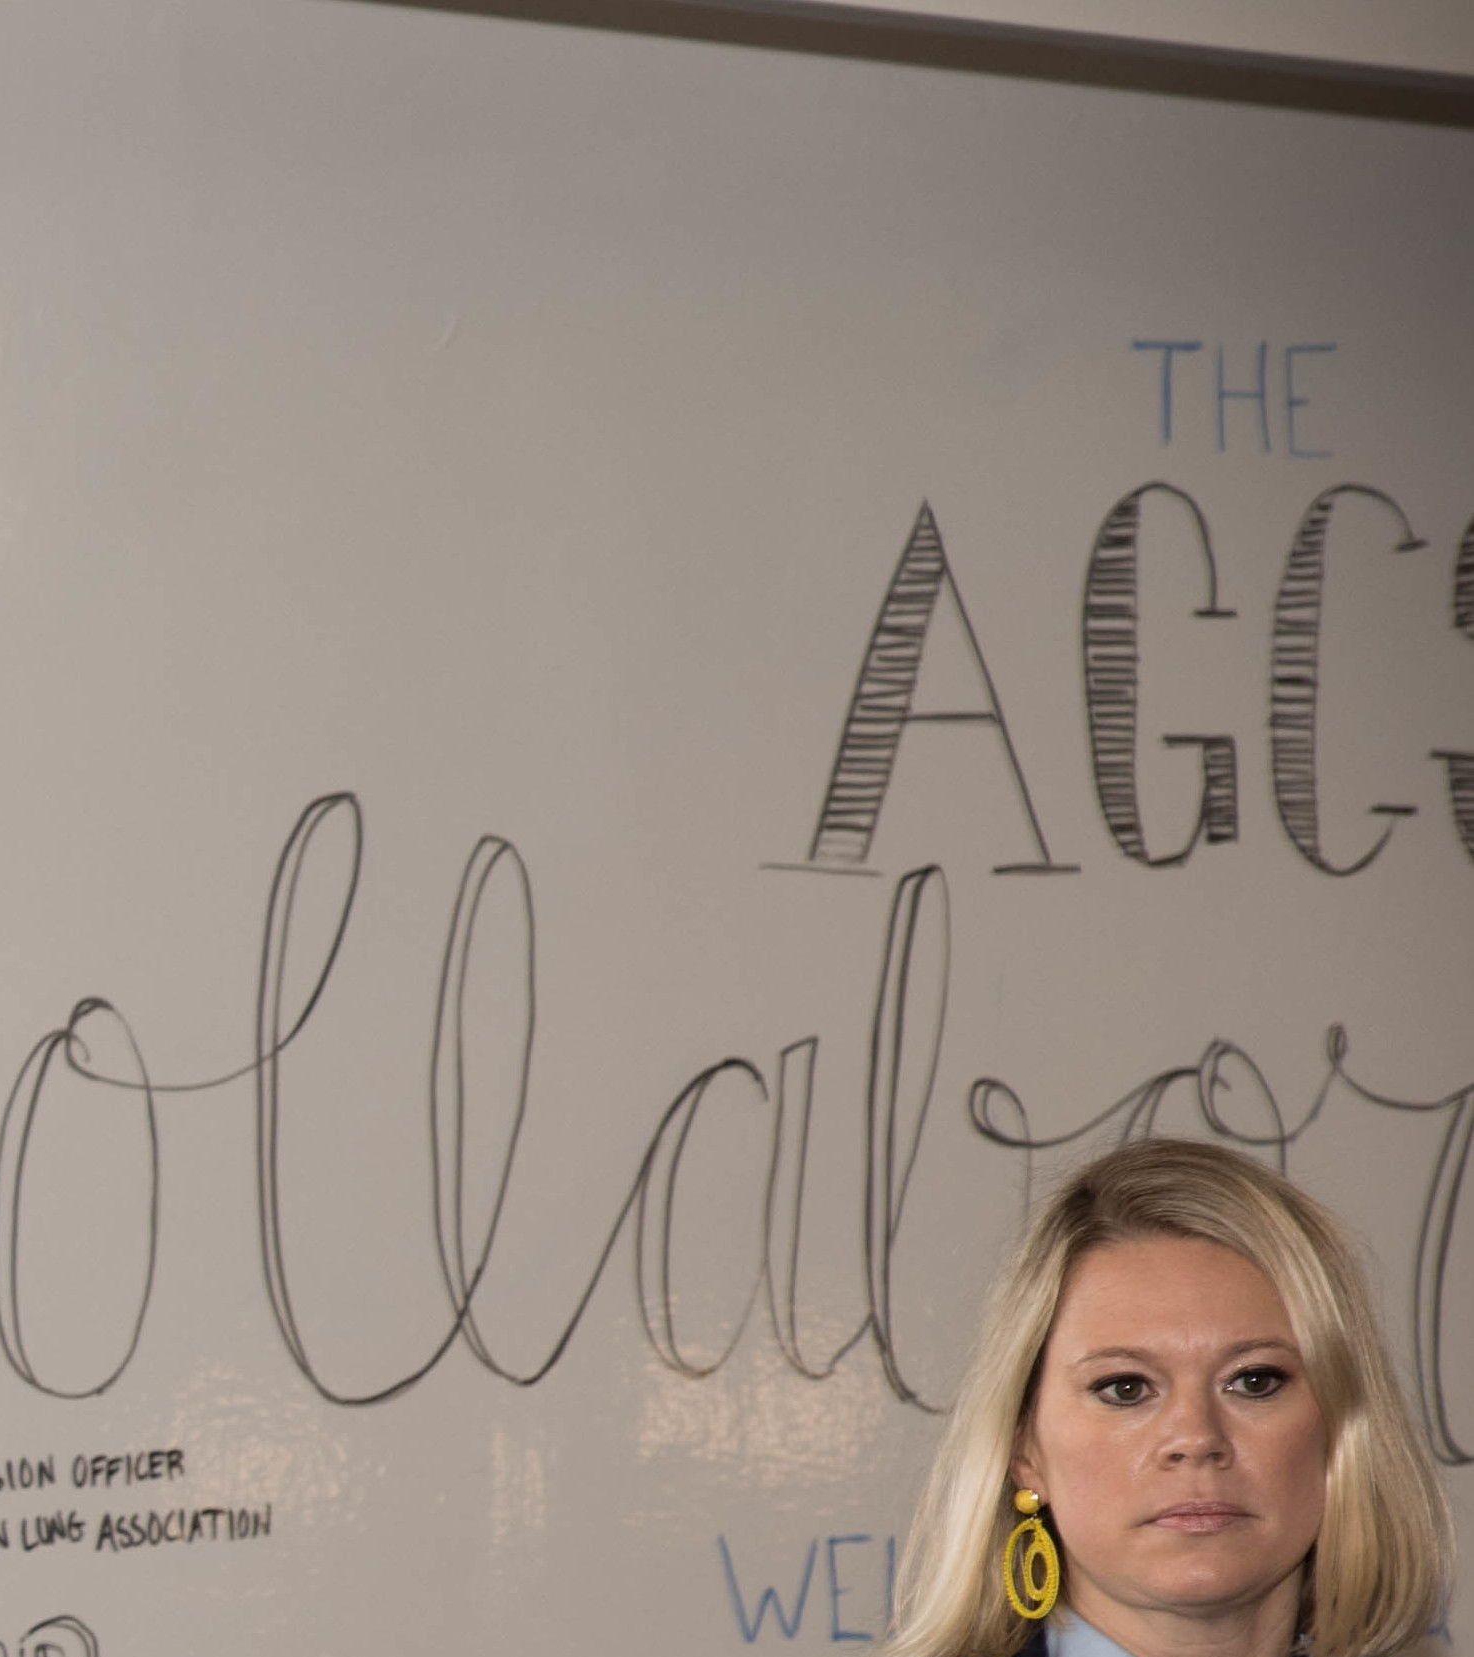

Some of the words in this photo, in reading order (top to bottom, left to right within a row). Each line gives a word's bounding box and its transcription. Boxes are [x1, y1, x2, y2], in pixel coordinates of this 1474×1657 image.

[1131, 339, 1338, 460] THE
[71, 1448, 186, 1490] OFFICER
[21, 1509, 86, 1552] LUNG
[94, 1502, 273, 1553] ASSOCIATION
